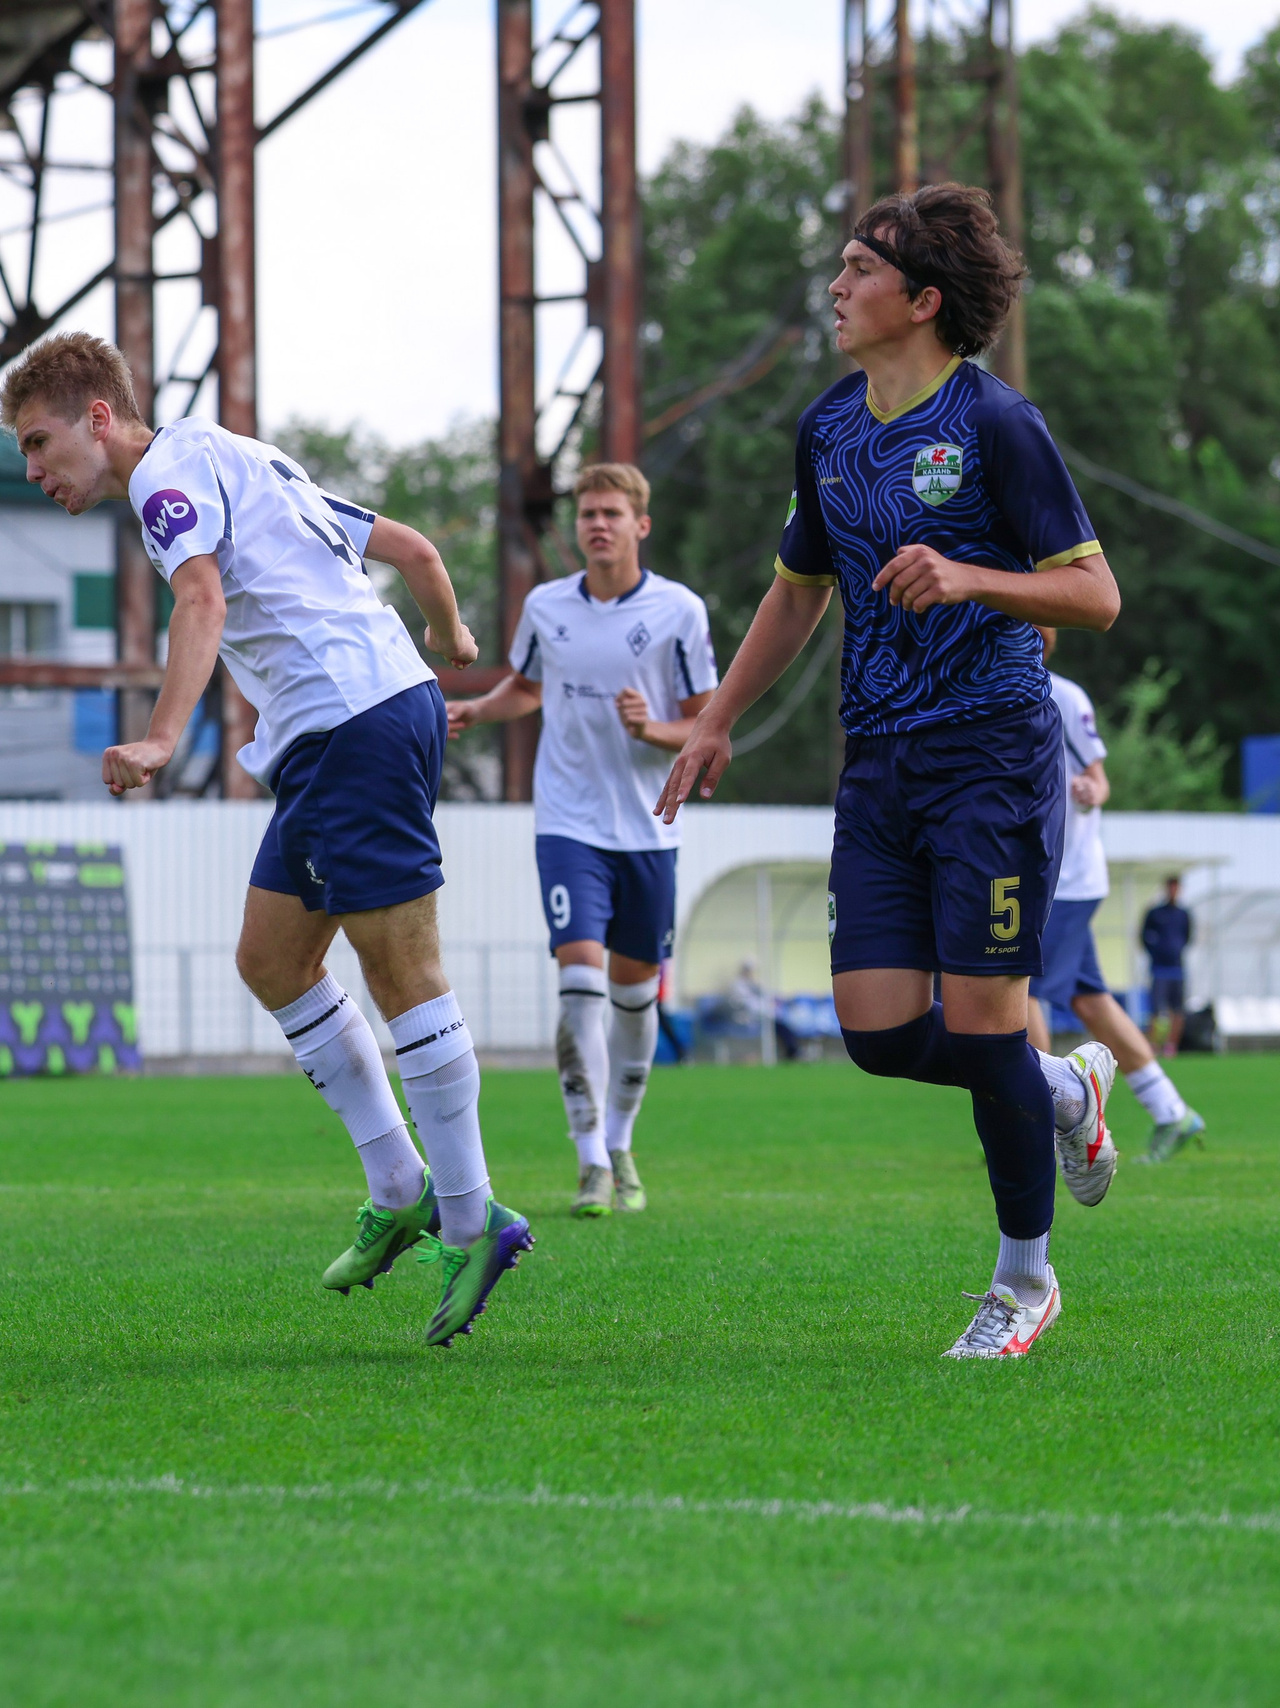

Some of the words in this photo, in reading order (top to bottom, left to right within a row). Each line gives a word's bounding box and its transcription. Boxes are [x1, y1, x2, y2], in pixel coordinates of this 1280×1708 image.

[922, 468, 952, 476] КАЗАНЬ
[151, 499, 190, 538] wb
[549, 884, 571, 930] 9
[990, 876, 1021, 941] 5
[997, 945, 1021, 954] SPORT
